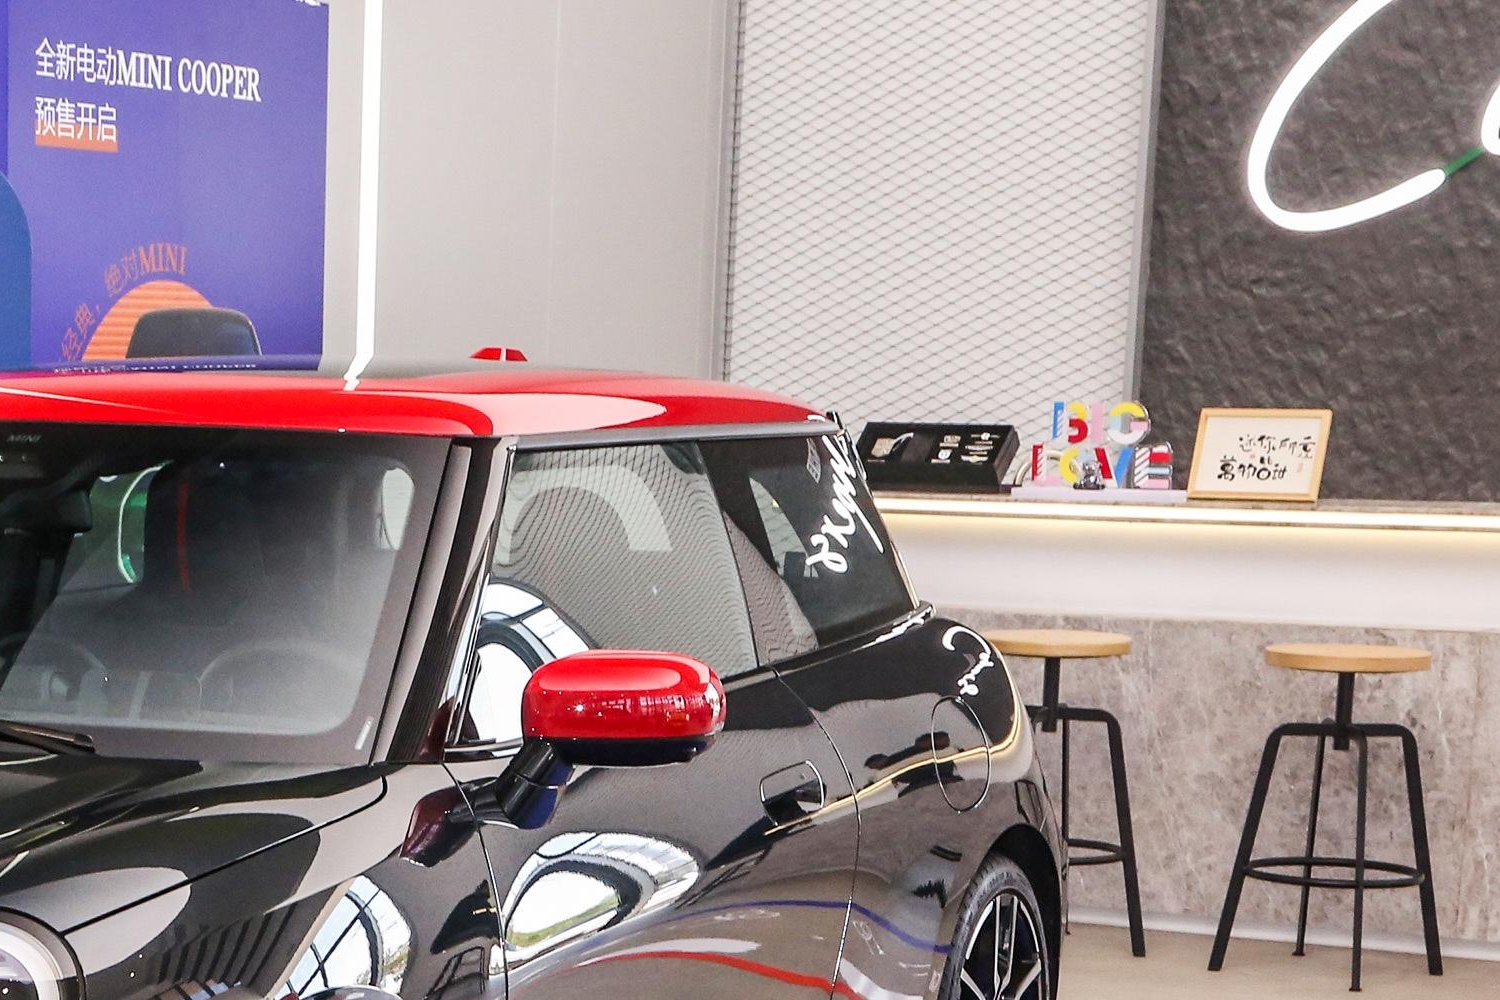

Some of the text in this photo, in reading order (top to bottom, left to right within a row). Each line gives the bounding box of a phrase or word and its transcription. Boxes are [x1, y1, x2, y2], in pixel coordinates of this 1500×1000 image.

[35, 37, 262, 103] 全新电动MINI COOPER
[35, 96, 117, 142] 预售开启
[1052, 400, 1151, 446] BIG
[1031, 441, 1173, 490] LOVE
